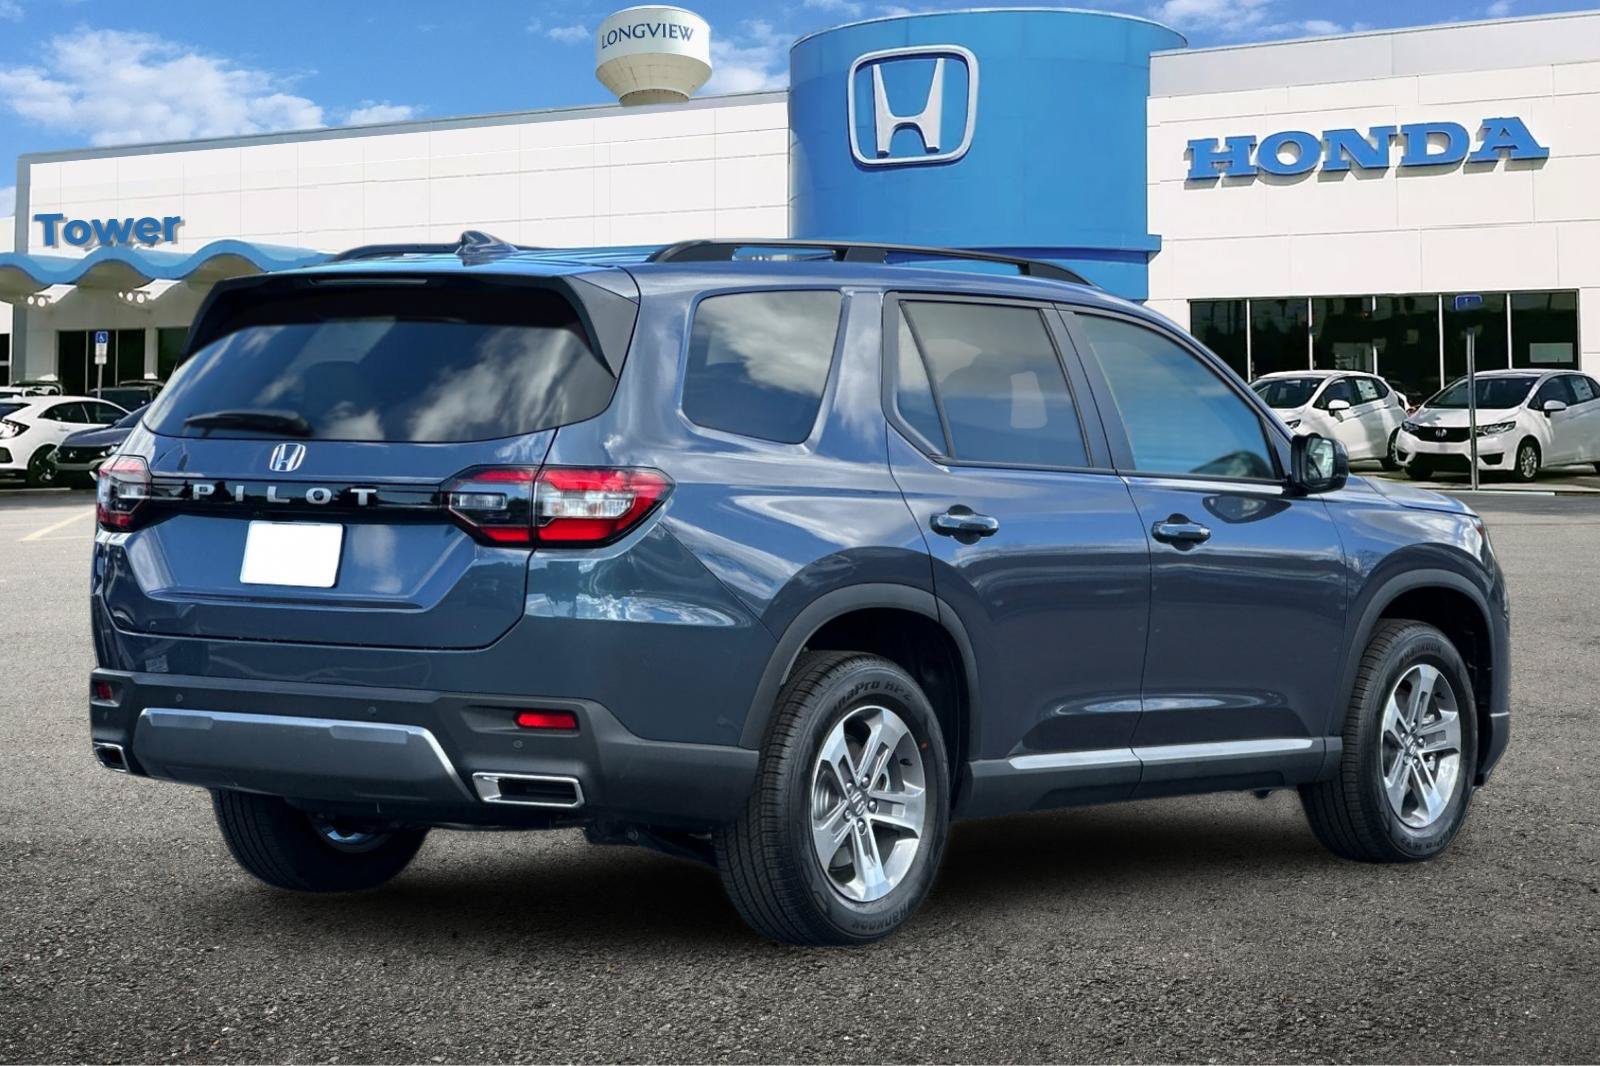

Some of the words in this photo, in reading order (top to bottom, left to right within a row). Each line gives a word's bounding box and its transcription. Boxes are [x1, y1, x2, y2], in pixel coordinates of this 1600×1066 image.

[601, 23, 694, 49] LONGVIEW
[1186, 116, 1550, 181] HONDA
[34, 213, 181, 246] Tower
[193, 484, 377, 506] PILOT
